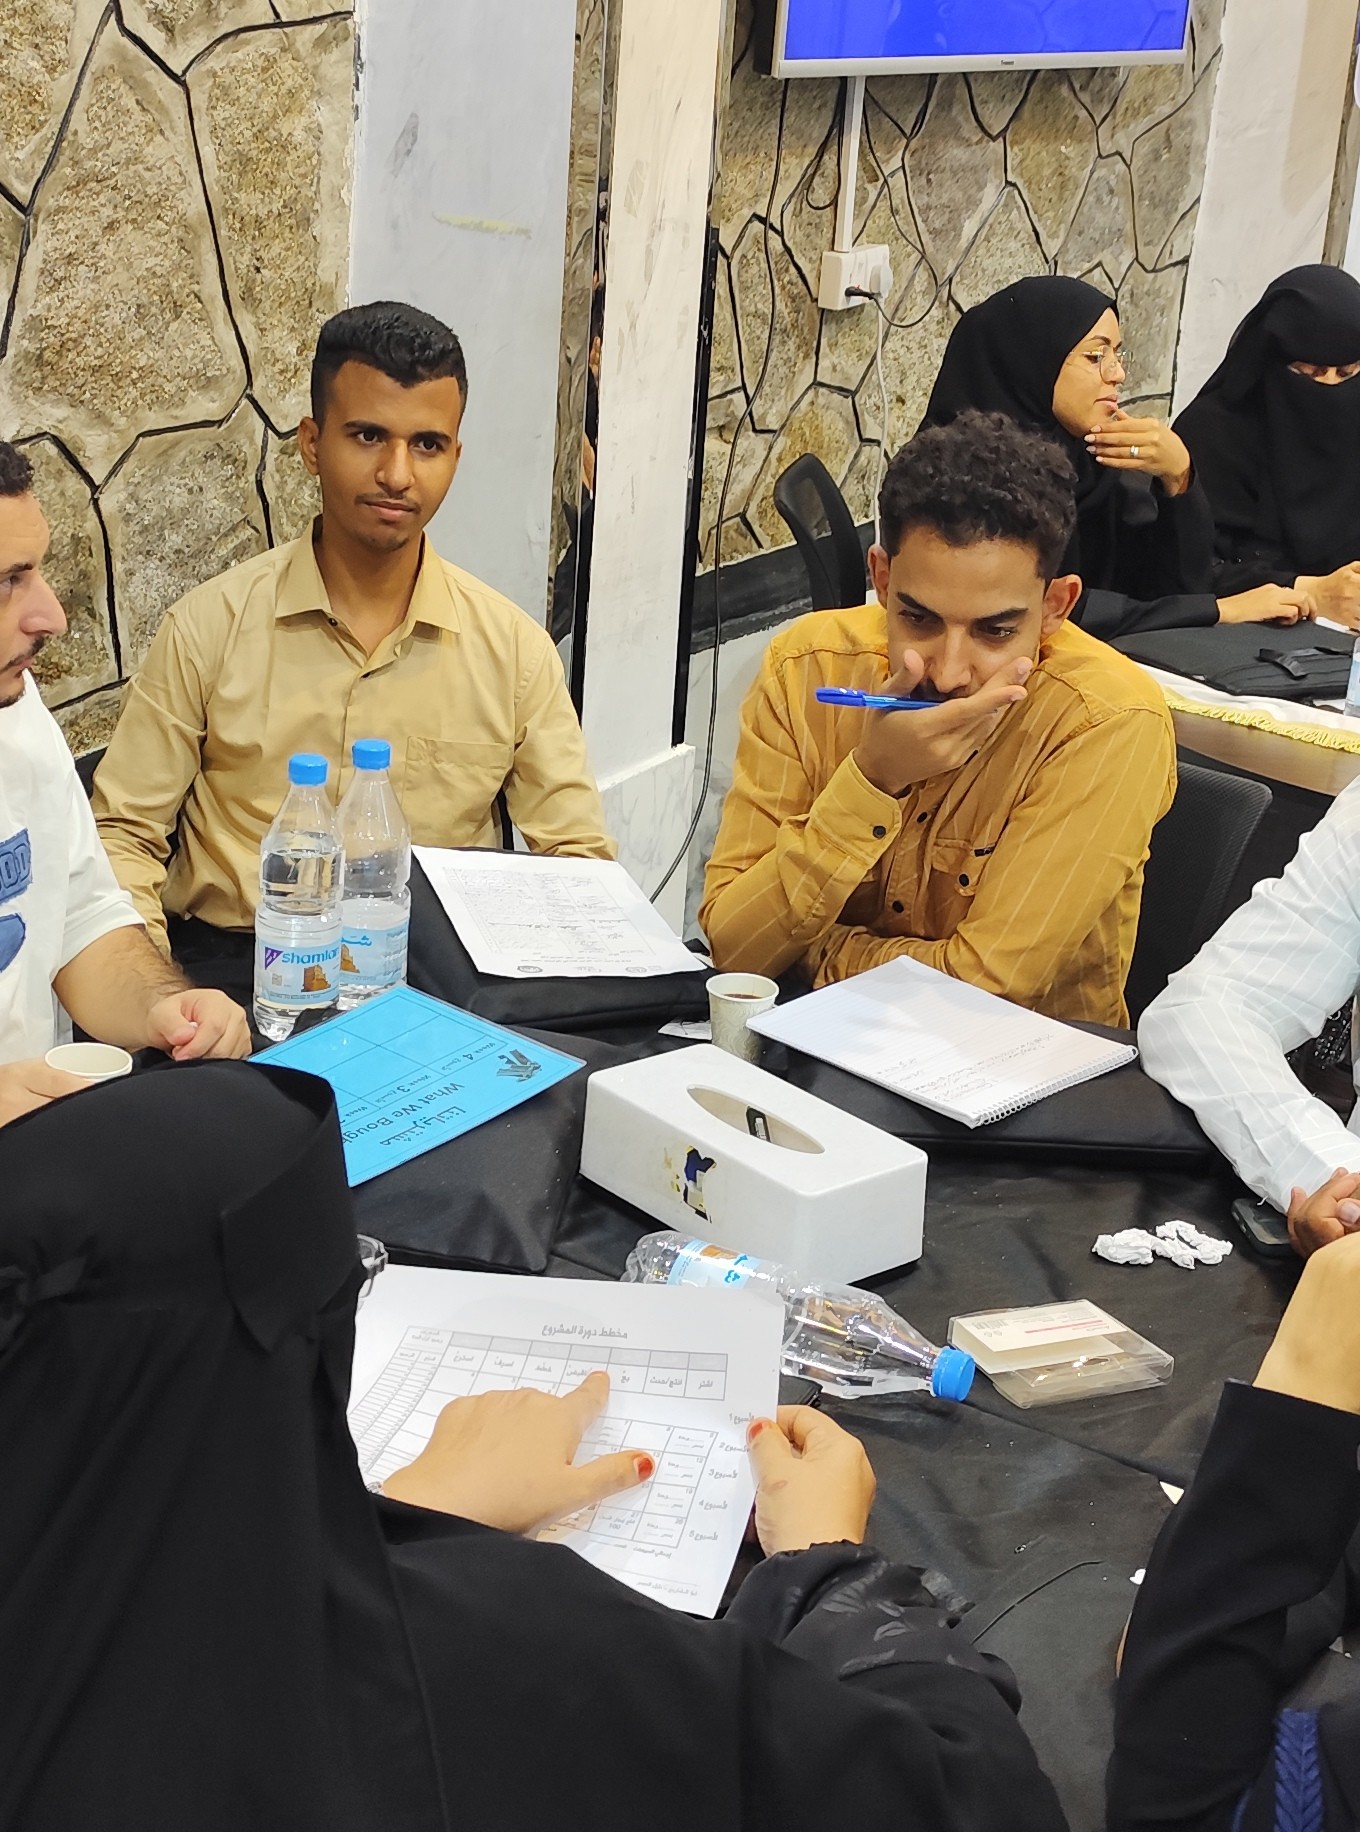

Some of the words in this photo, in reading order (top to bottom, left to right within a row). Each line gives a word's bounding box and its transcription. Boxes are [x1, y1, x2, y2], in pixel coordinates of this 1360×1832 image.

[281, 947, 339, 964] shamla
[417, 1082, 465, 1105] What
[391, 1103, 423, 1119] We
[343, 1116, 394, 1144] Bough
[379, 1105, 468, 1146] مشترياتنا
[541, 1324, 578, 1337] المشروع
[579, 1325, 597, 1339] دورة
[599, 1327, 628, 1339] مخطط
